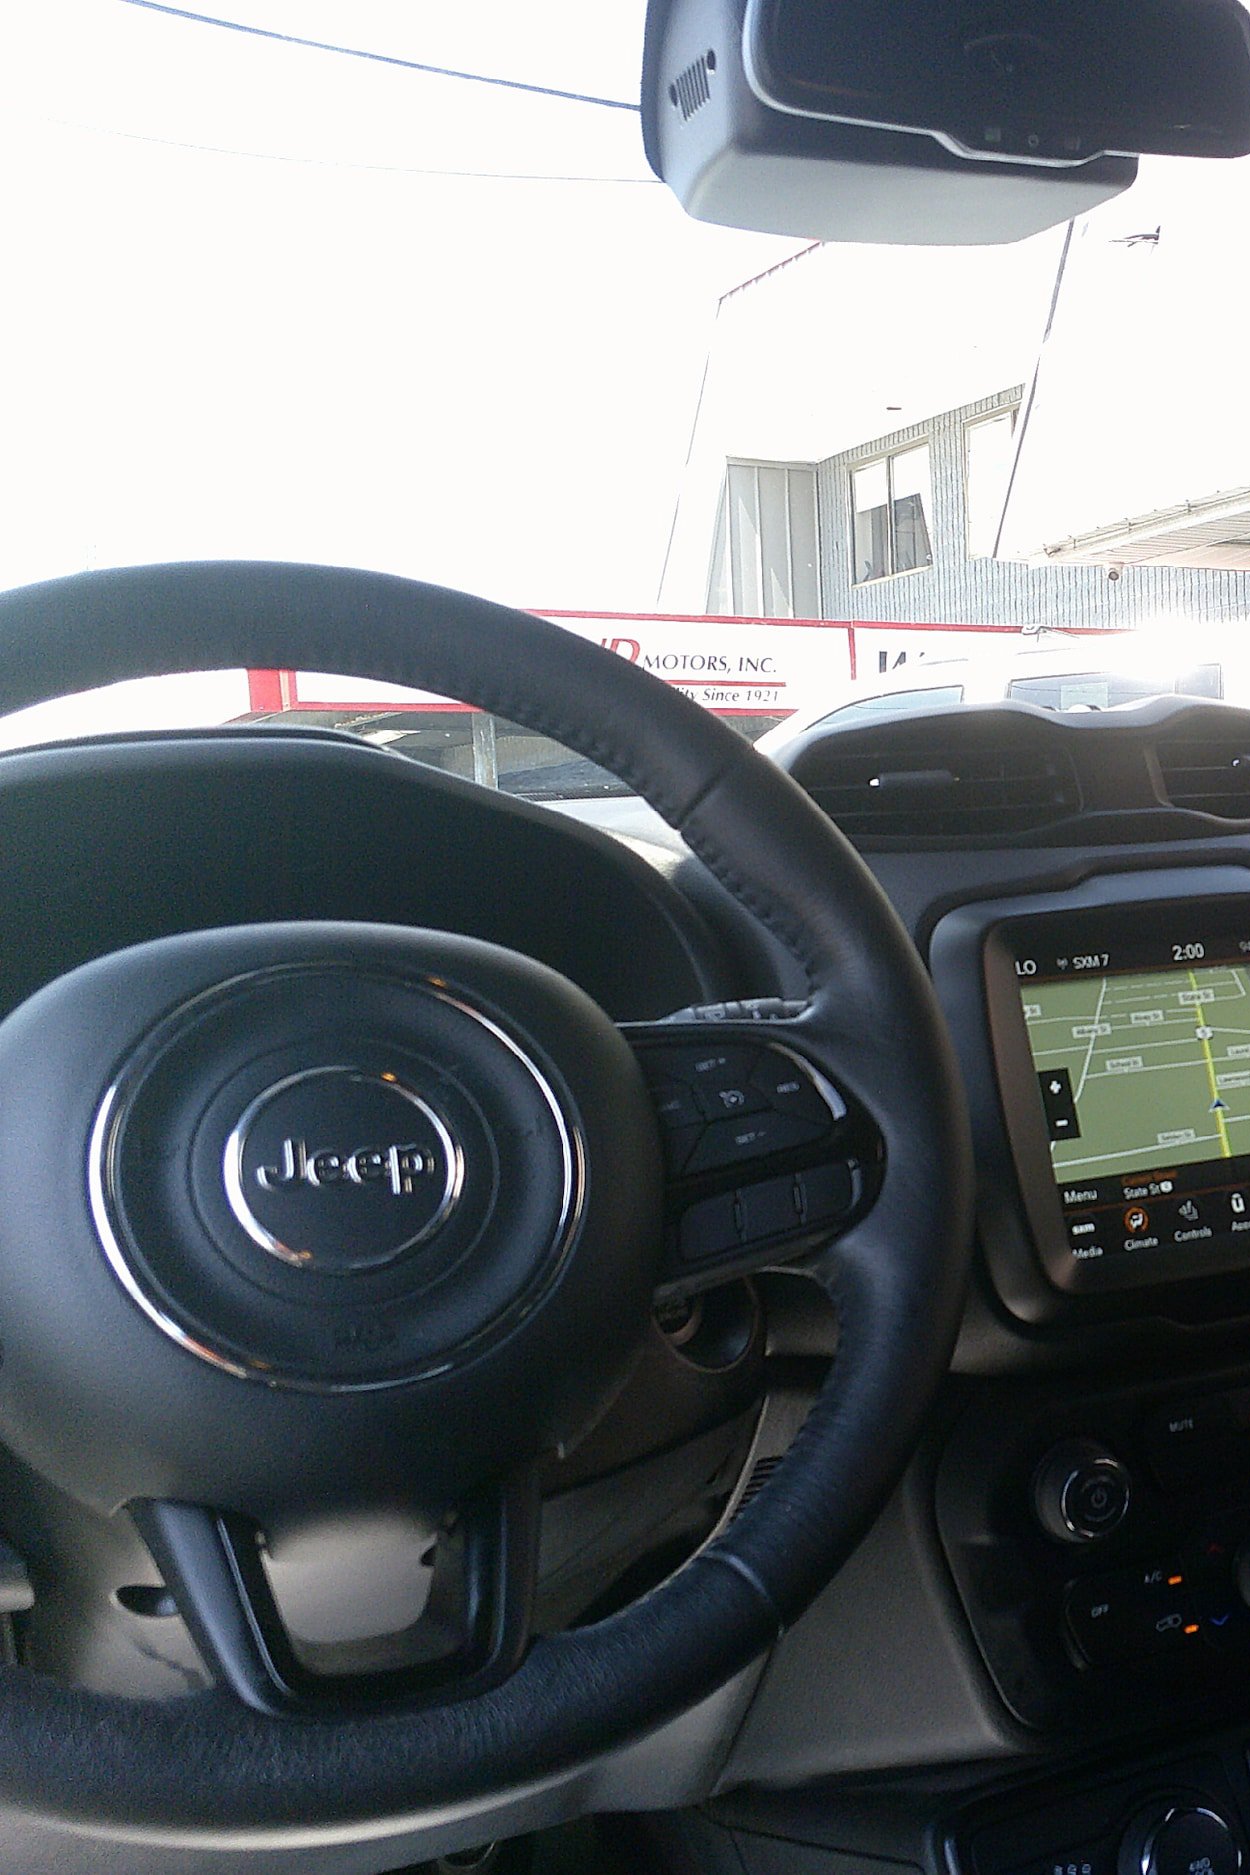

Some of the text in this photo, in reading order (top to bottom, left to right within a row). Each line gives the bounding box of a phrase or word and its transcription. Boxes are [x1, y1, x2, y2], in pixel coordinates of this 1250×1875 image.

[643, 654, 732, 674] MOTORS,
[738, 657, 777, 673] INC.
[702, 688, 740, 702] Since
[745, 690, 779, 702] 1921
[1171, 943, 1205, 961] 2:00
[1015, 960, 1037, 976] LO
[1072, 954, 1110, 970] SXM 7
[256, 1138, 436, 1196] Jeep
[1064, 1188, 1098, 1204] Menu
[1123, 1186, 1149, 1200] State
[1174, 1225, 1213, 1242] Controls
[1124, 1236, 1159, 1251] Climate
[1072, 1246, 1103, 1259] Media
